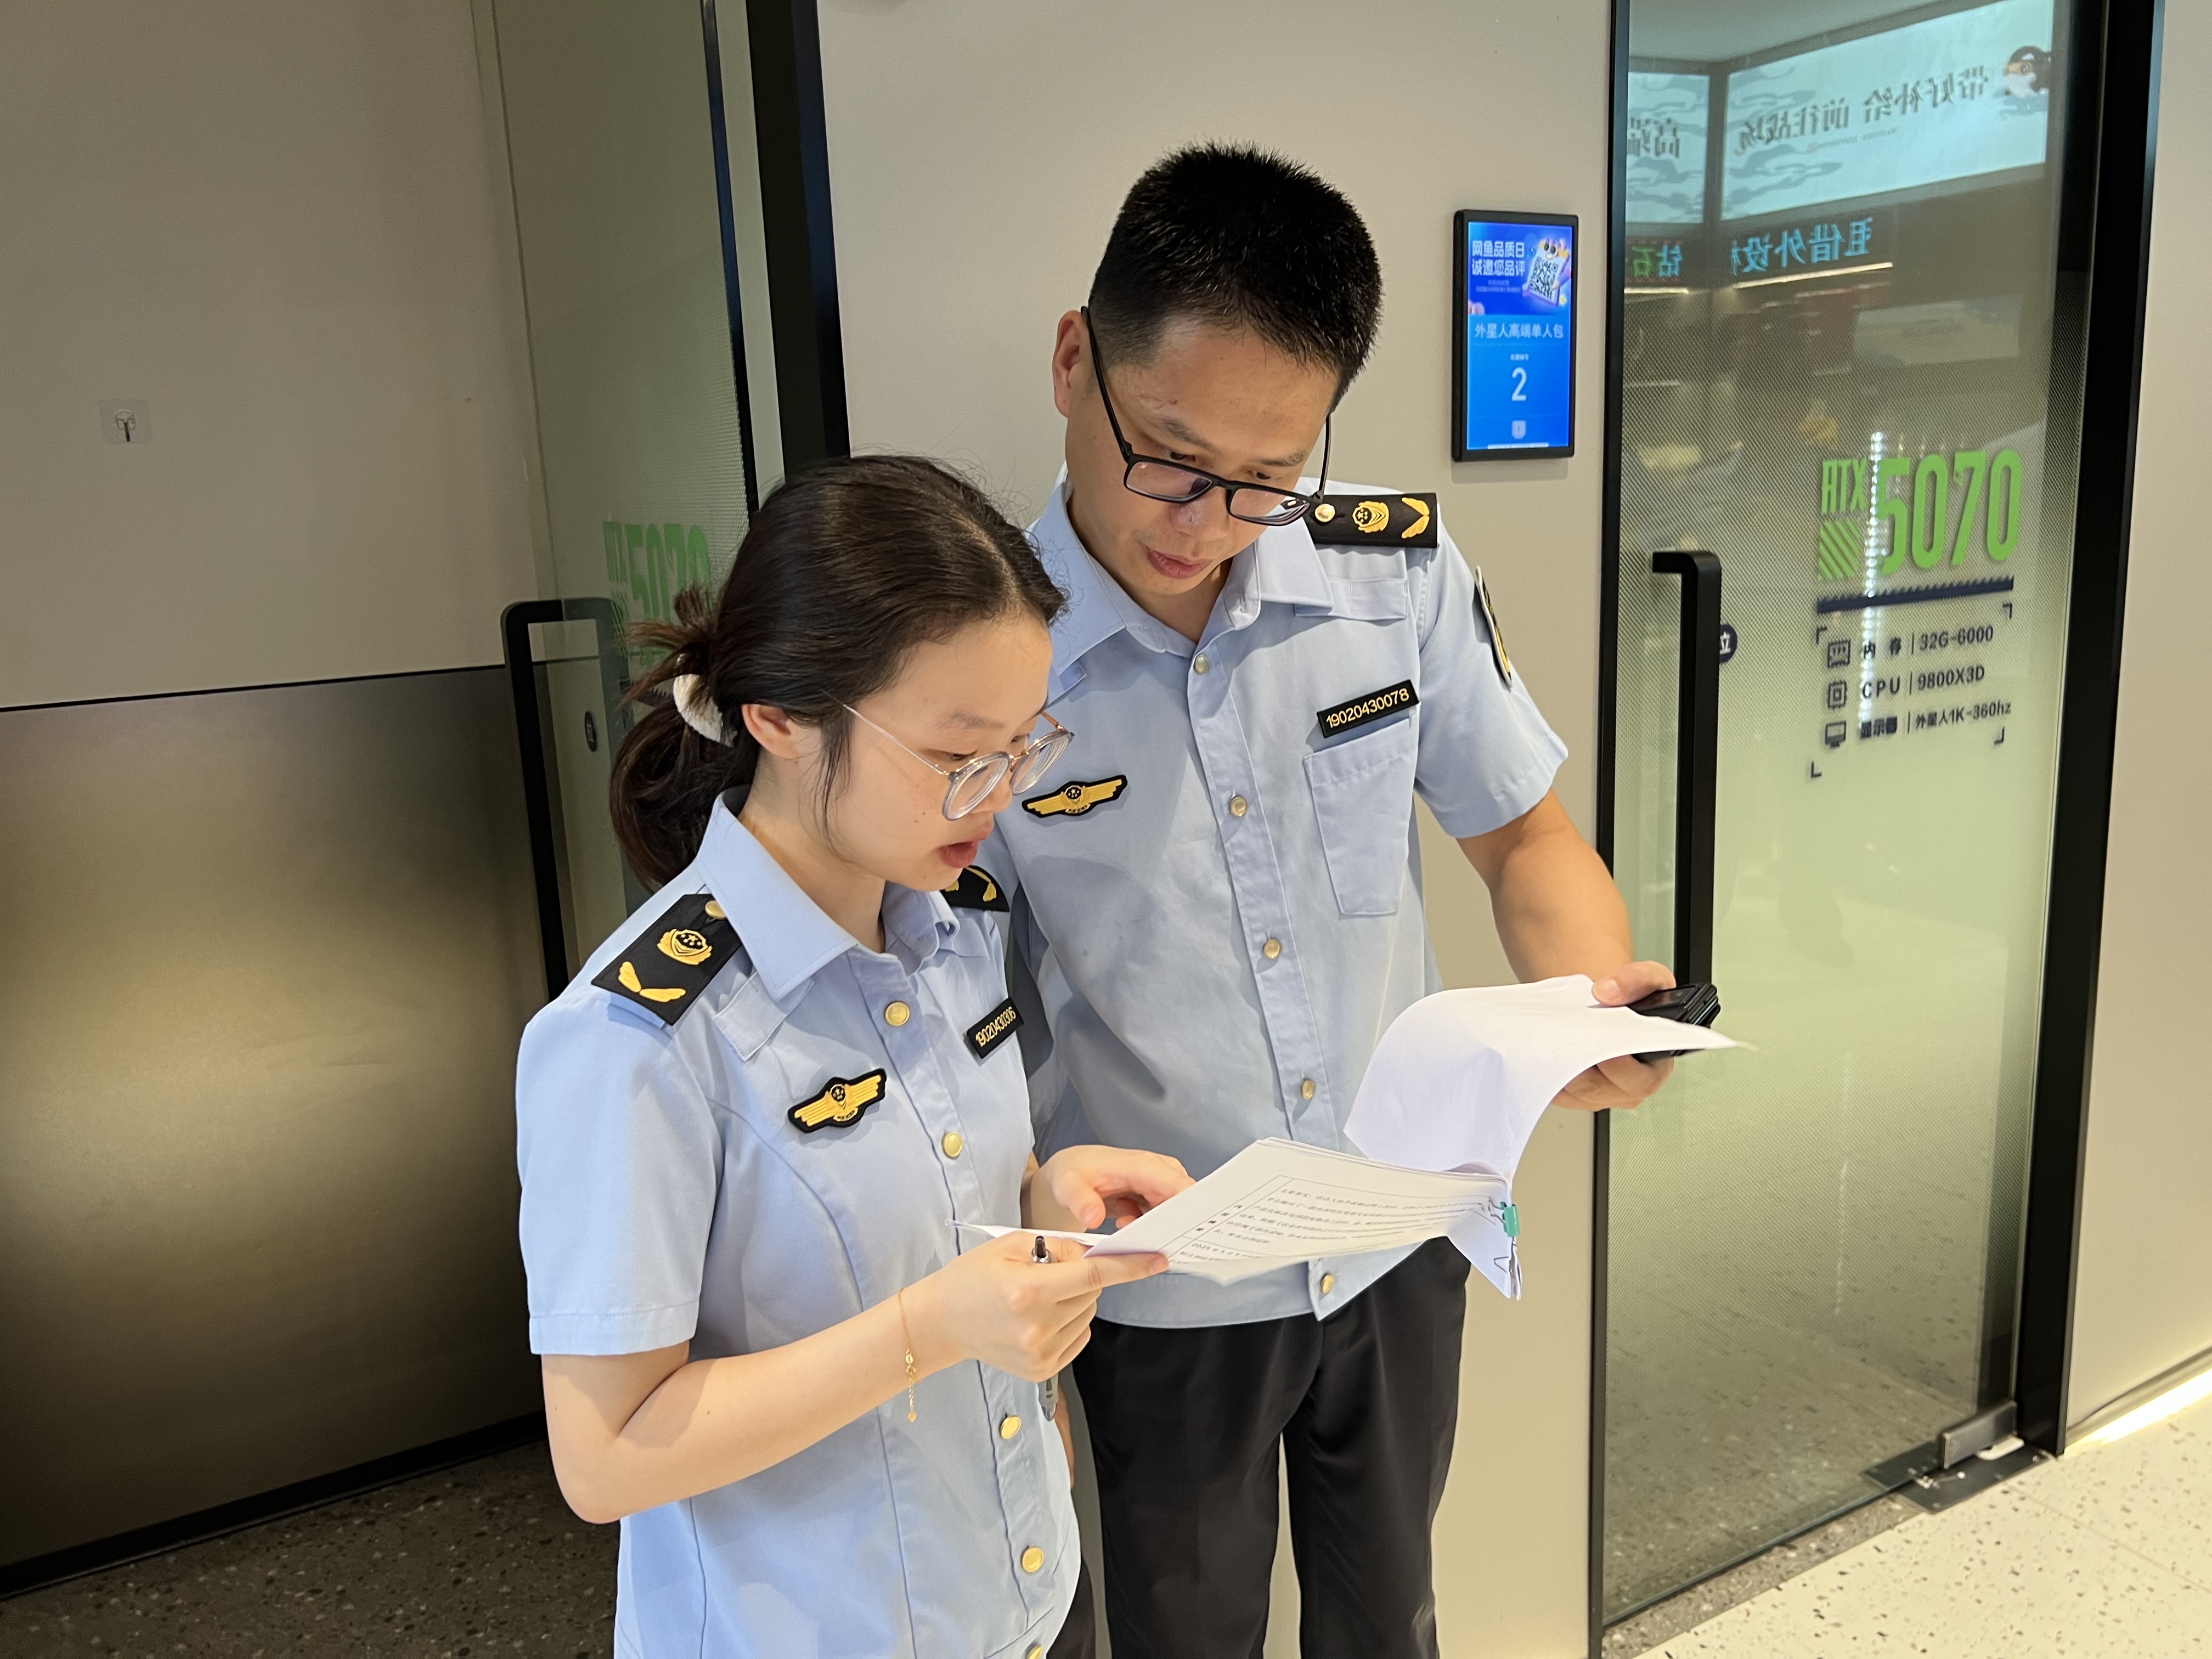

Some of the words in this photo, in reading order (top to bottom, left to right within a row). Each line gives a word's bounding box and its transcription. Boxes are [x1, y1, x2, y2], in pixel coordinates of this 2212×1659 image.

[1472, 240, 1525, 258] 网鱼品质日
[1472, 259, 1525, 276] 诚邀您品评
[1475, 323, 1564, 339] 外星人高端单人包
[1511, 367, 1527, 401] 2
[1873, 449, 2022, 576] 5070
[1920, 624, 1994, 651] 32G-6000
[1862, 676, 1900, 698] CPU
[1917, 664, 1985, 691] 9800X3D
[1326, 688, 1409, 728] 19020430078
